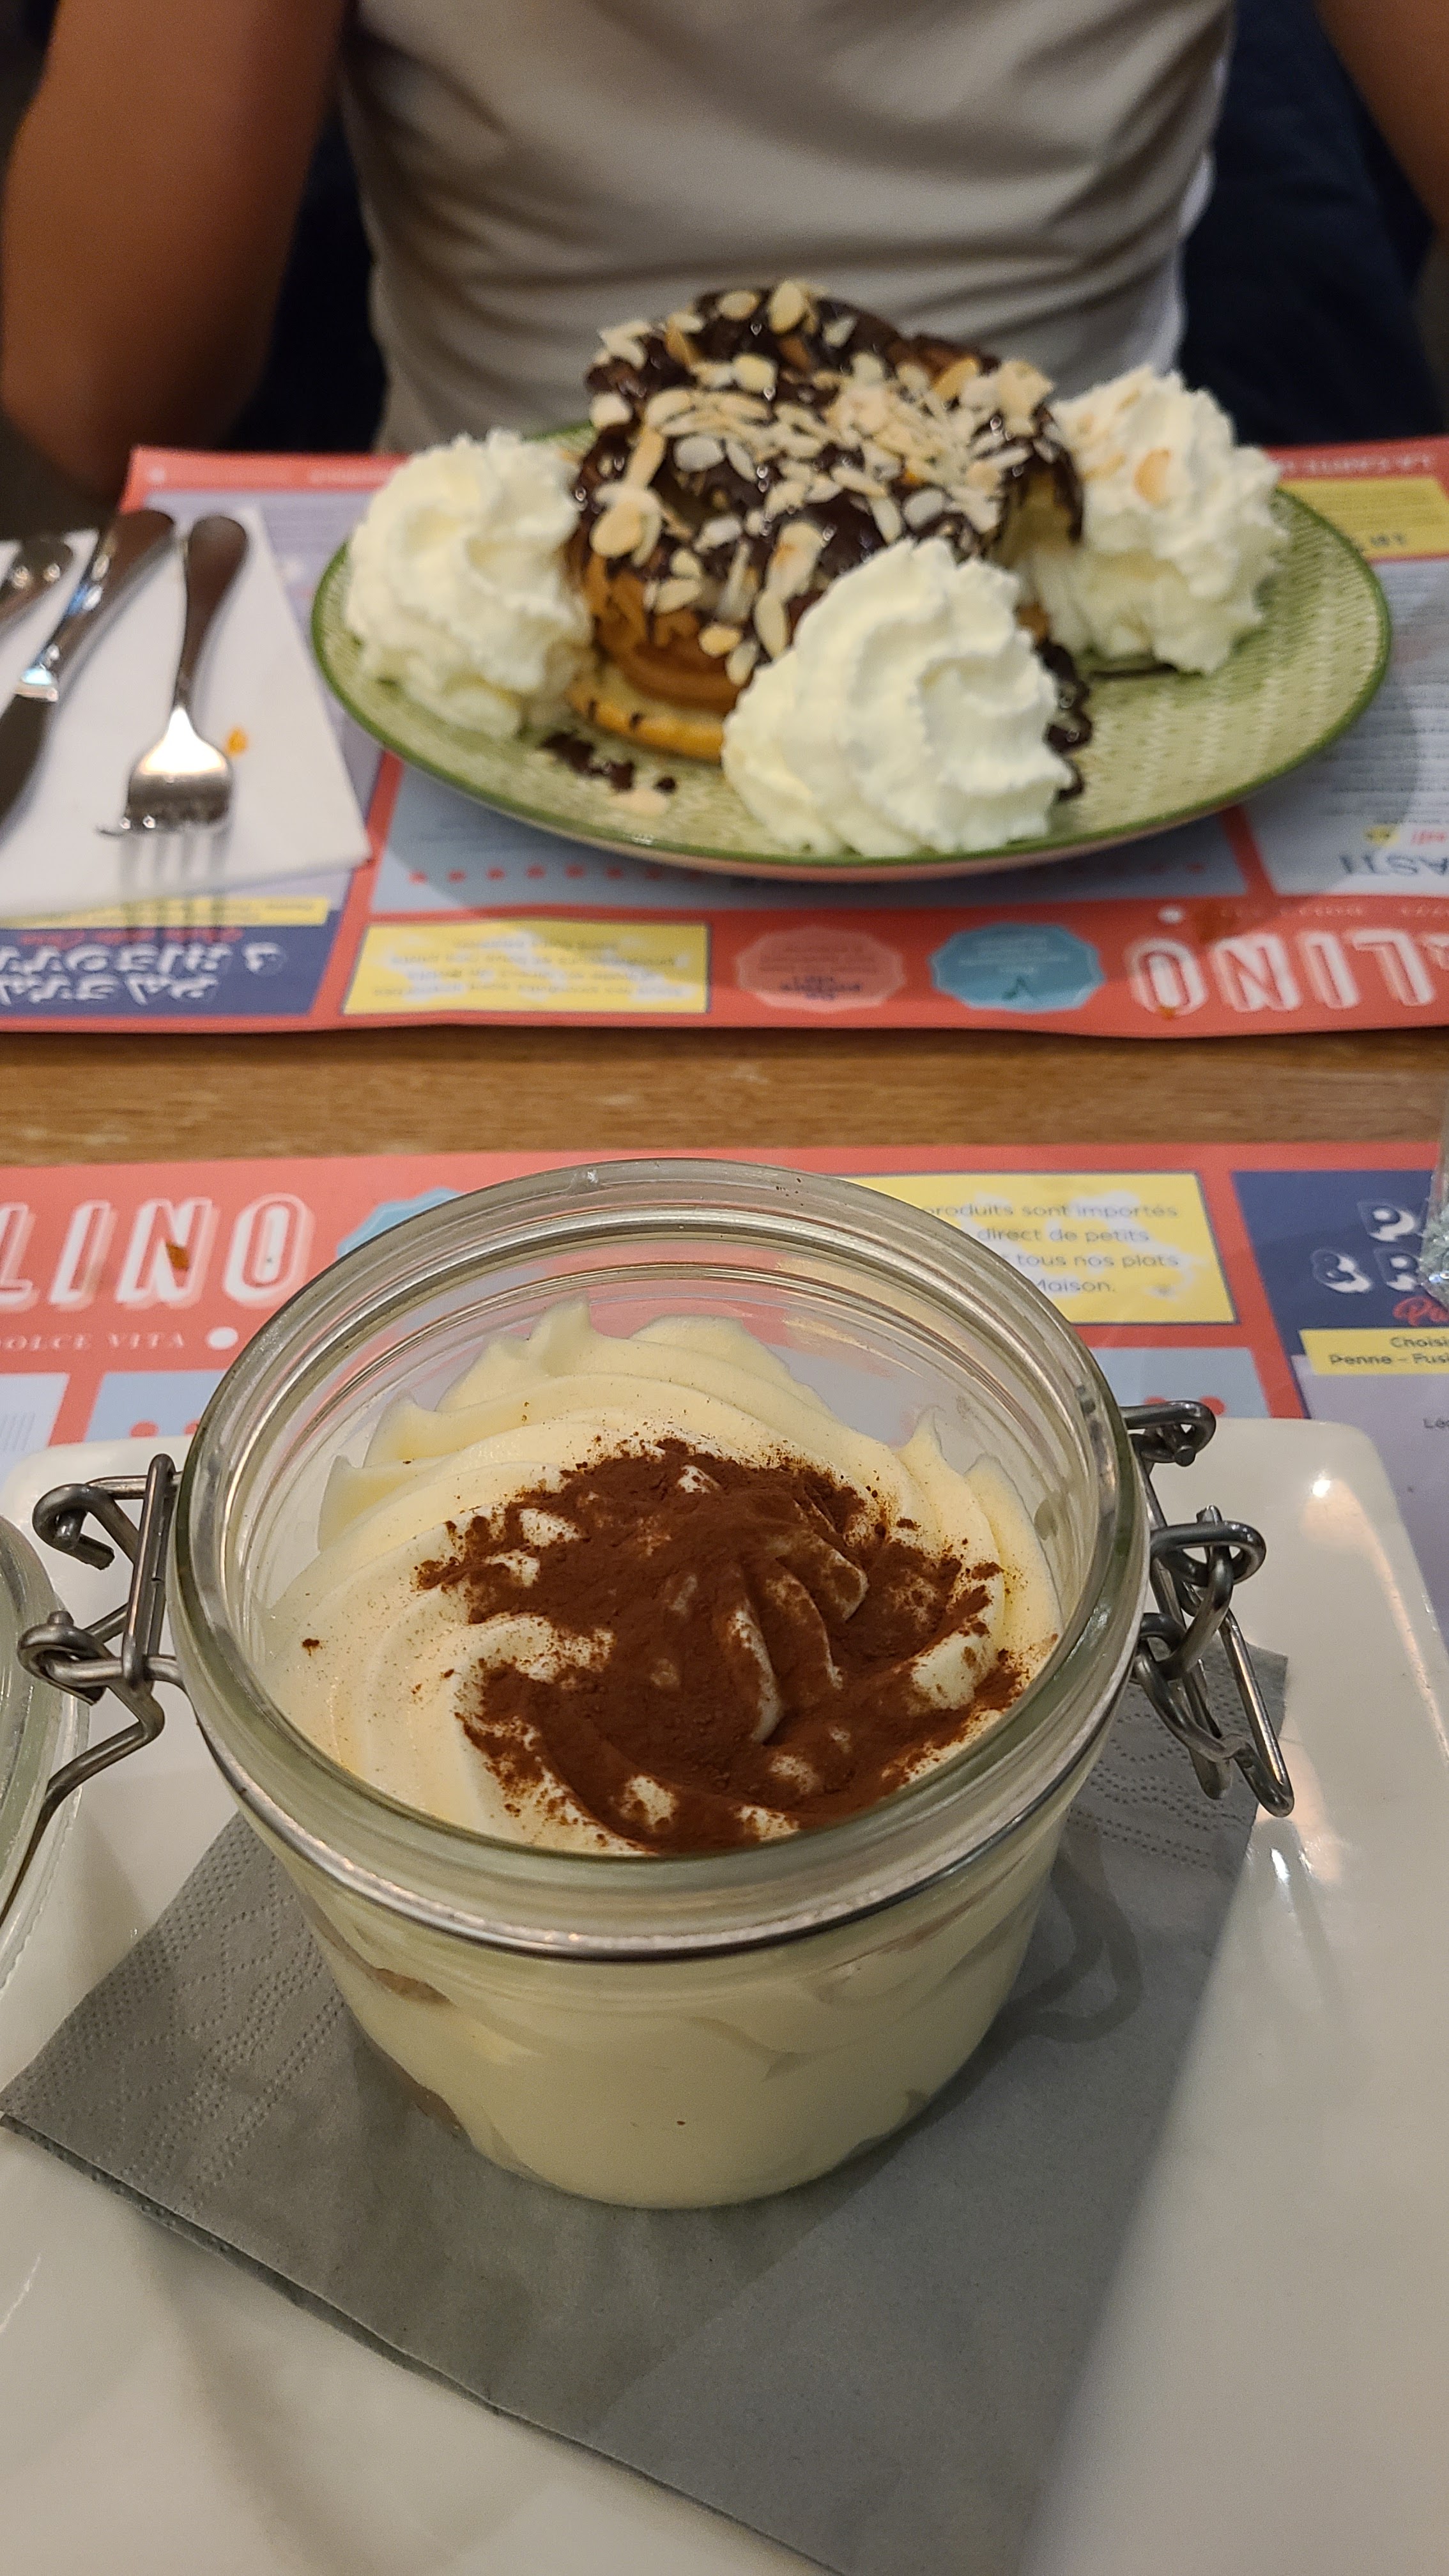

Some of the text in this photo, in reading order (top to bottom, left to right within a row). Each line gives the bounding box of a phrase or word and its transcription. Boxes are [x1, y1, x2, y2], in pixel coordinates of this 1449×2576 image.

[1123, 926, 1449, 1016] LINO
[1022, 1203, 1067, 1216] sont
[1077, 1203, 1177, 1218] importés
[977, 1227, 1150, 1243] direct de petits
[1017, 1254, 1179, 1269] tous nos plats
[107, 1331, 185, 1349] VITA
[1329, 1353, 1392, 1365] Penne
